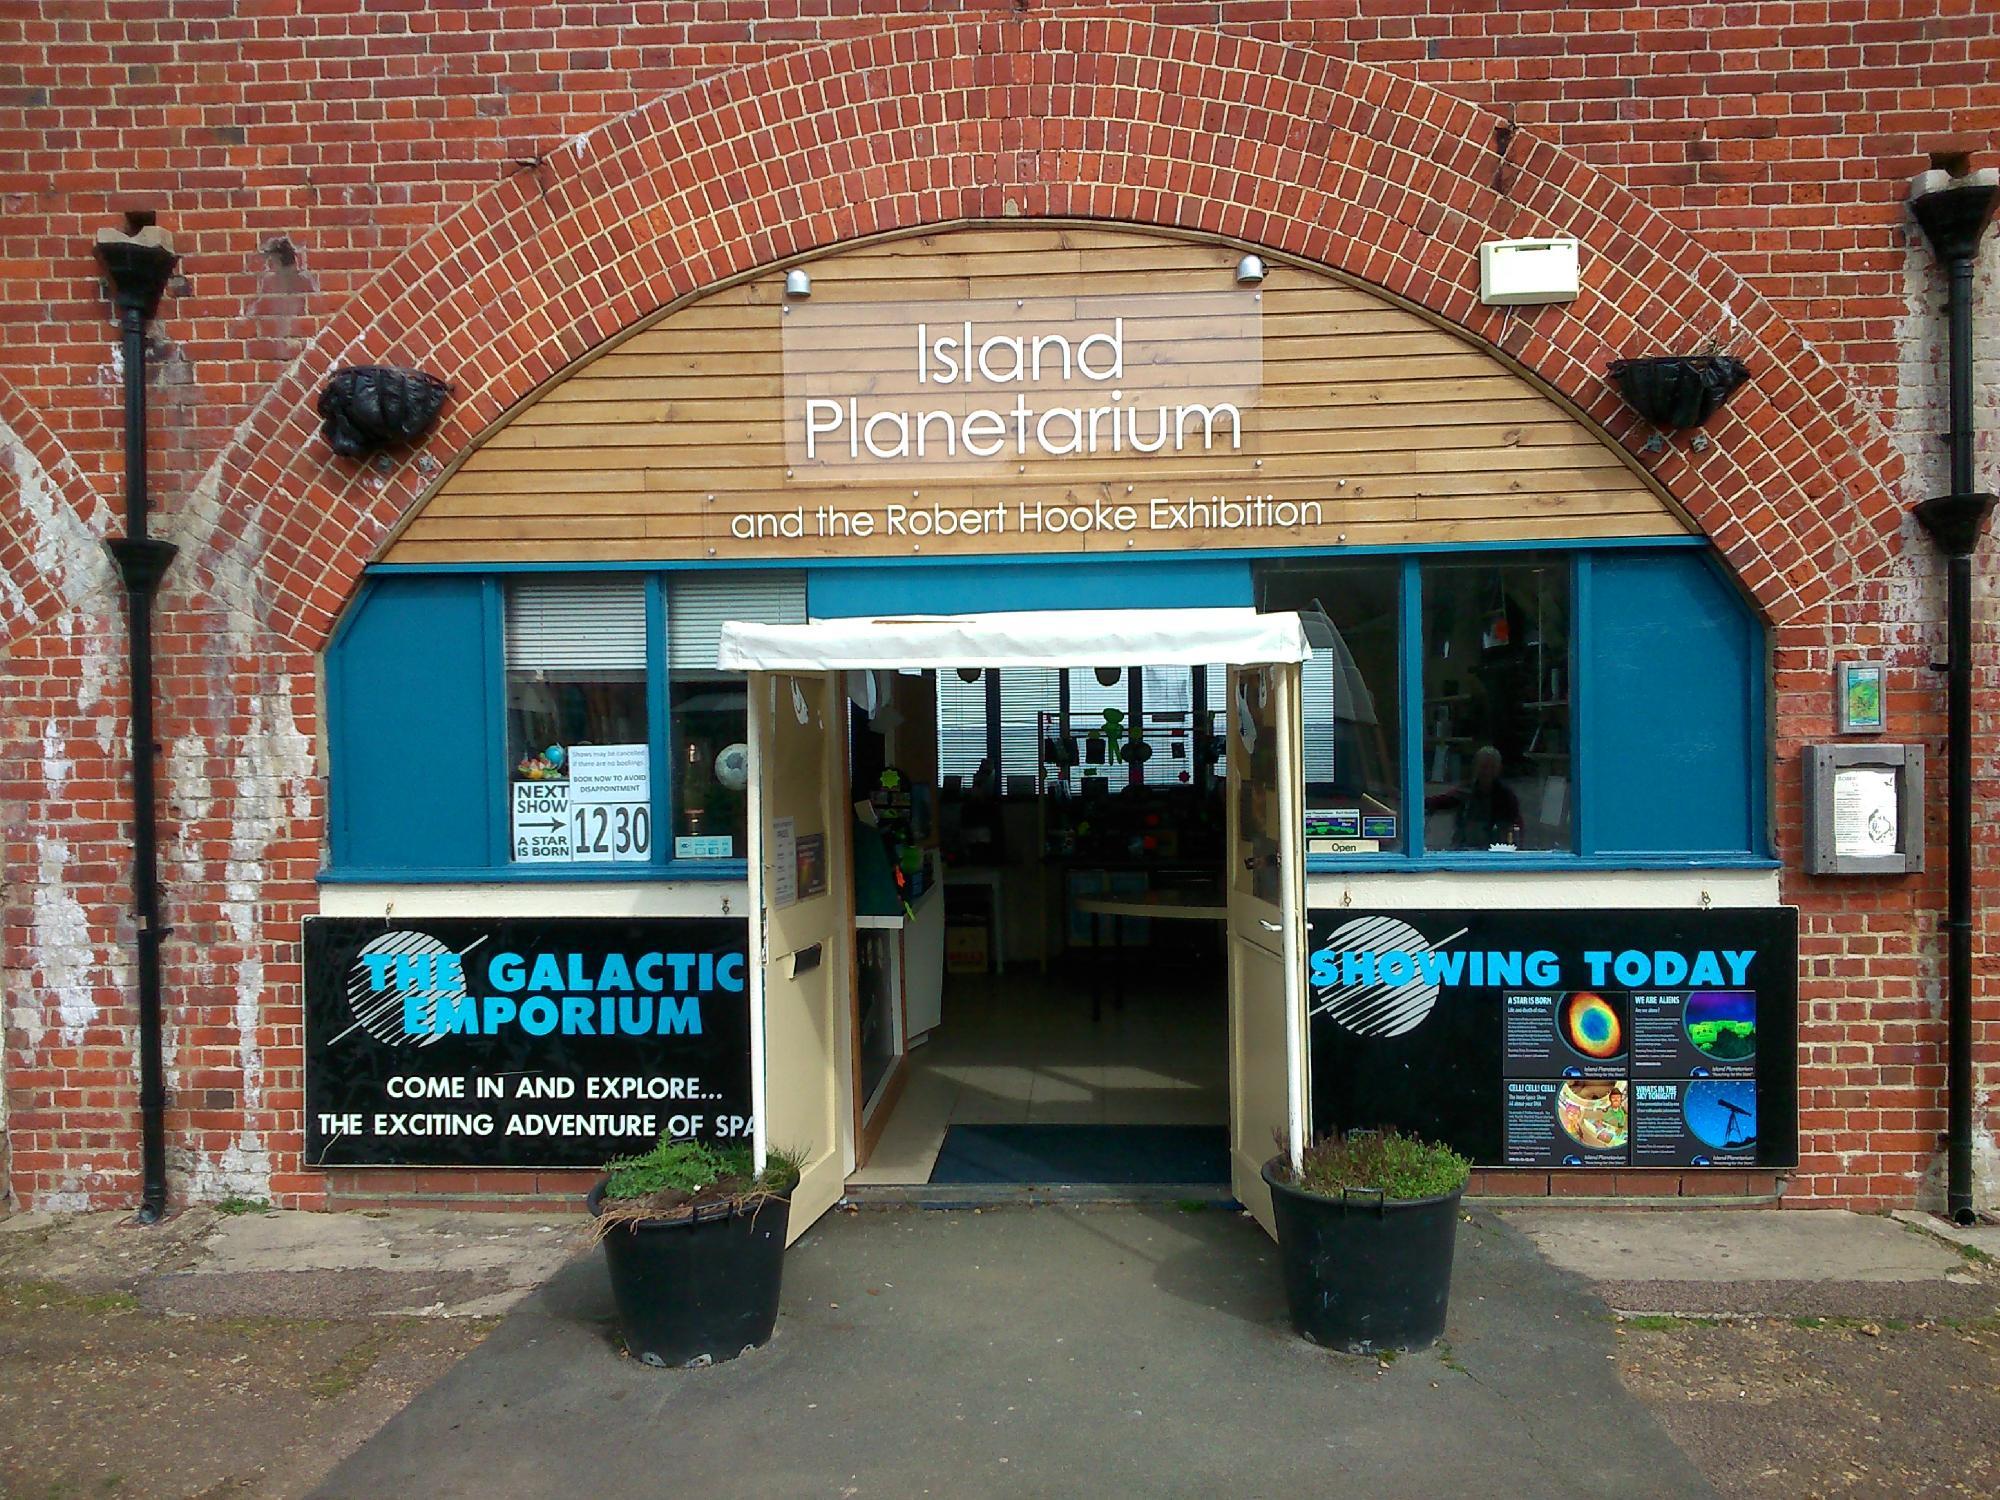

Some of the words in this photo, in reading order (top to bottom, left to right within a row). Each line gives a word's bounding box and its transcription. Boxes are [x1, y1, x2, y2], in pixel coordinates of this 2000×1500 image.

[918, 317, 1123, 384] Island
[805, 390, 1241, 460] Planetarium
[731, 507, 804, 538] and
[815, 505, 874, 537] the
[886, 501, 1008, 536] Robert
[1019, 499, 1137, 533] Hooke
[1149, 495, 1323, 531] Exhibition
[518, 785, 570, 798] NEXT
[580, 784, 640, 793] DISAPPOINTMENT
[517, 800, 568, 813] SHOW
[518, 837, 528, 845] A
[532, 836, 567, 845] STAR
[517, 847, 528, 856] IS
[532, 847, 569, 856] BORN
[1331, 843, 1356, 853] Open
[363, 953, 463, 991] THE
[488, 952, 744, 992] GALACTIC
[1310, 949, 1560, 988] SHOWING
[1585, 949, 1757, 987] TODAY
[1507, 997, 1512, 1005] A
[1513, 996, 1528, 1005] STAR
[1528, 996, 1534, 1005] IS
[1535, 996, 1552, 1005] BORN
[1634, 996, 1645, 1004] WE
[1645, 996, 1657, 1004] ARE
[1659, 996, 1680, 1004] ALIENS
[404, 997, 703, 1036] EMPORIUM
[386, 1076, 465, 1099] COME
[477, 1076, 504, 1098] IN
[515, 1076, 575, 1098] AND
[586, 1076, 723, 1100] EXPLORE...
[1508, 1084, 1524, 1092] CELL!
[1525, 1084, 1540, 1092] CELL!
[1541, 1084, 1556, 1092] CELL!
[1636, 1085, 1658, 1093] WHATS
[1665, 1085, 1677, 1093] THE
[1636, 1092, 1648, 1100] SKY
[1648, 1092, 1677, 1100] TONIGHT?
[318, 1113, 362, 1136] THE
[374, 1113, 494, 1136] EXCITING
[505, 1114, 656, 1137] ADVENTURE
[667, 1114, 704, 1137] OF
